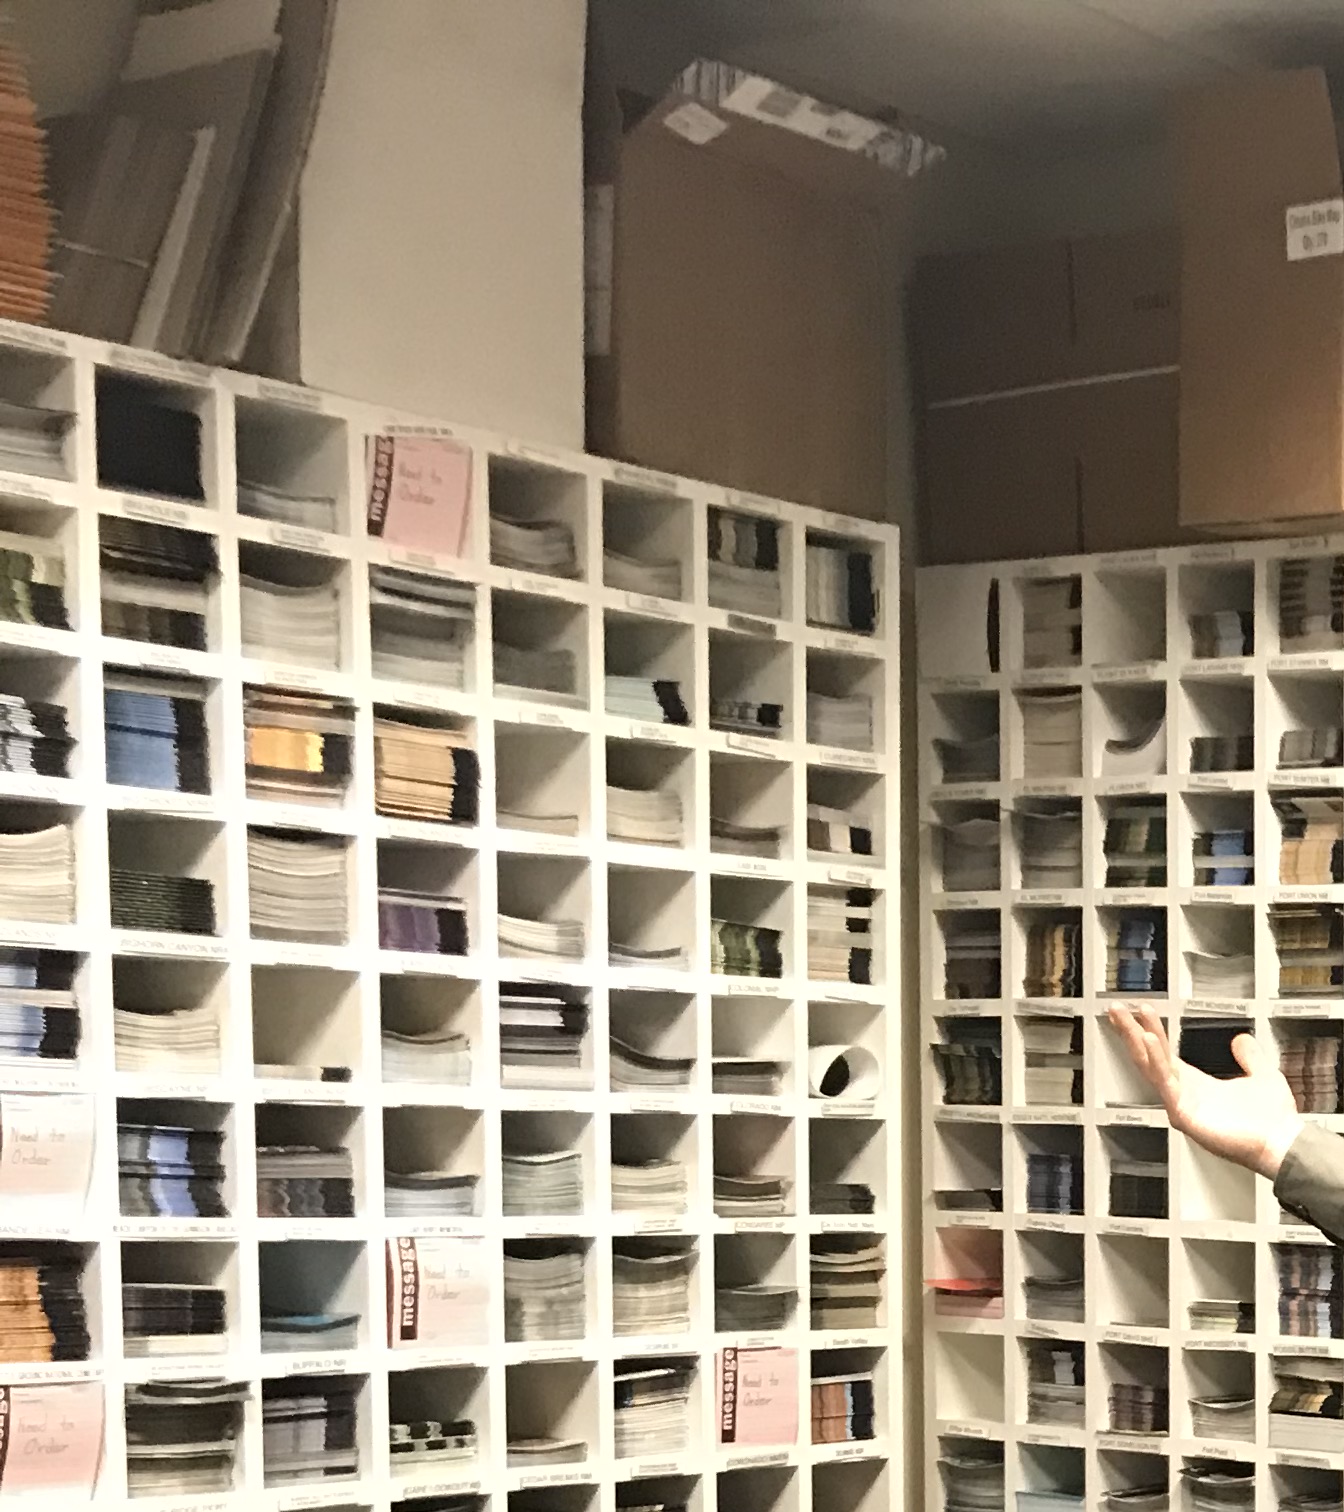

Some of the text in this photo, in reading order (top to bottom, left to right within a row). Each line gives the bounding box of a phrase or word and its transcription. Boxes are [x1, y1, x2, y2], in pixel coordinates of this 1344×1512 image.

[11, 1126, 66, 1143] Need to
[11, 1150, 52, 1166] Order
[400, 1237, 416, 1326] message
[427, 1285, 460, 1300] Order
[722, 1348, 735, 1431] message
[743, 1392, 771, 1407] Order
[18, 1413, 75, 1433] Need to
[24, 1439, 69, 1455] Order
